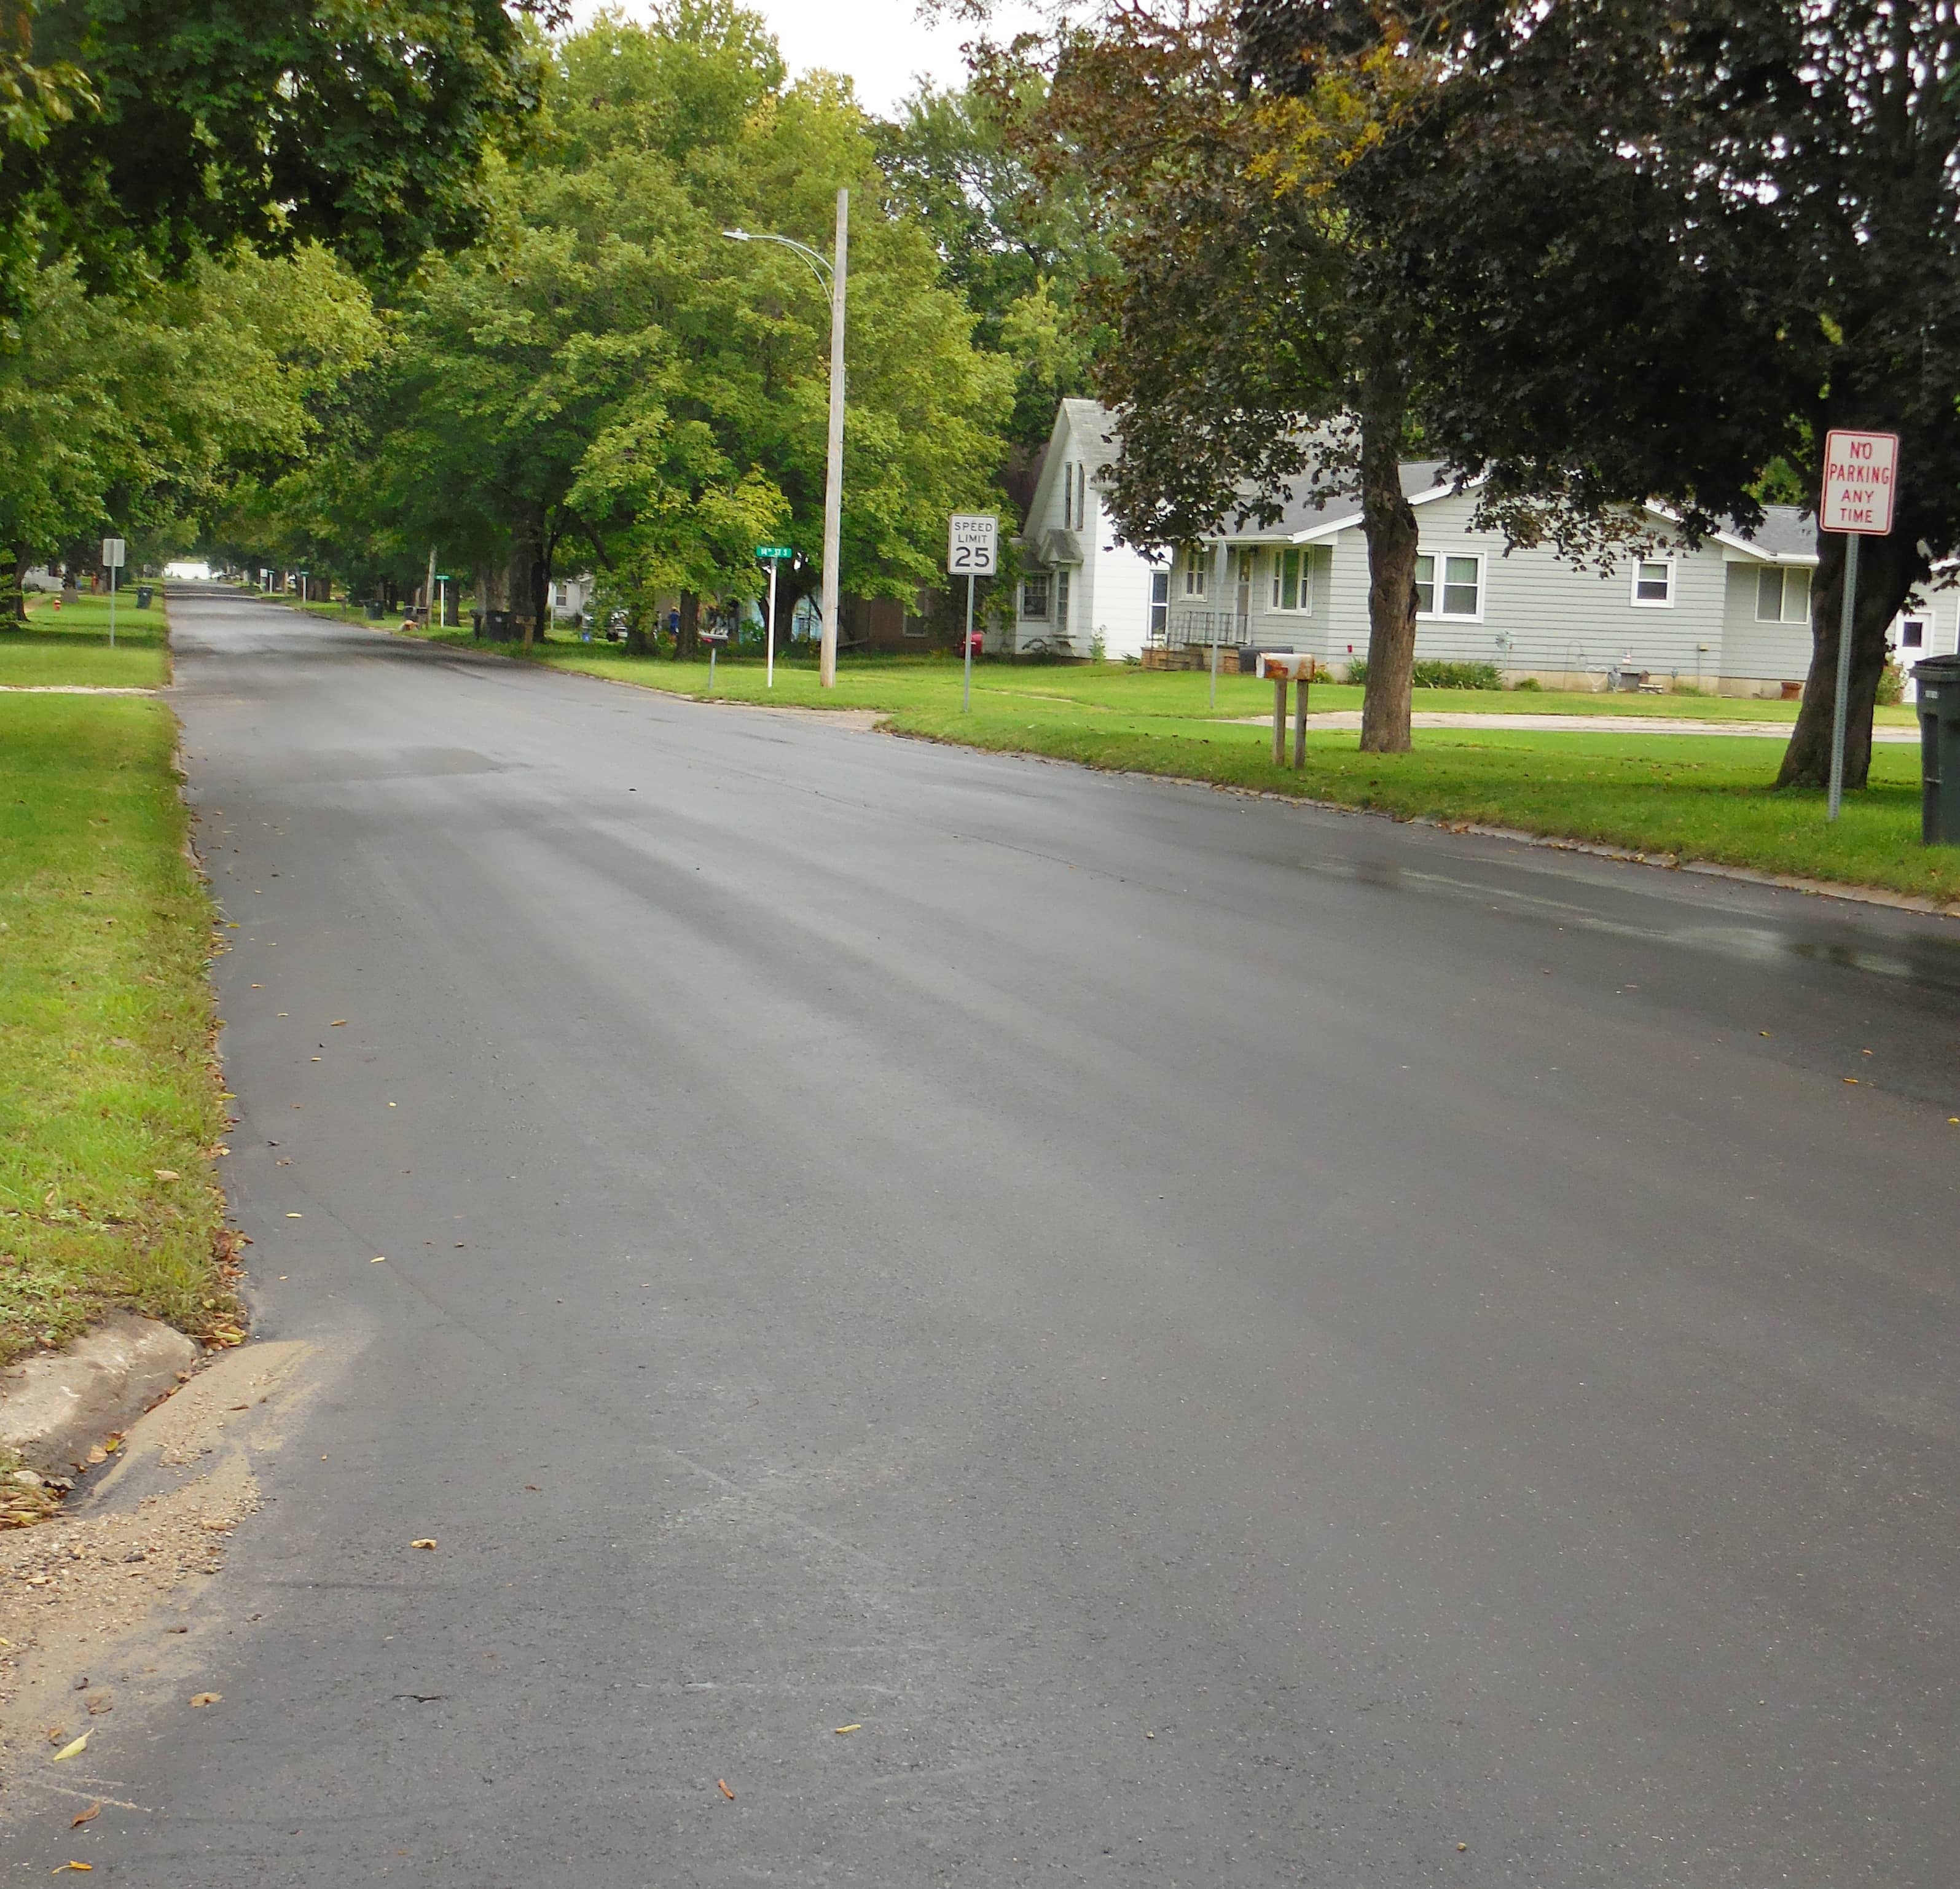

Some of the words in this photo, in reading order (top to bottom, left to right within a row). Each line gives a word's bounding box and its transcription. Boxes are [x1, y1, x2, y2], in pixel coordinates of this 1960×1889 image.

[1849, 441, 1873, 460] NO
[1829, 463, 1889, 484] PARKING
[1840, 489, 1874, 504] ANY
[1840, 508, 1873, 523] TIME
[954, 522, 992, 532] SPEED
[958, 534, 988, 543] LIMIT
[955, 546, 990, 568] 25
